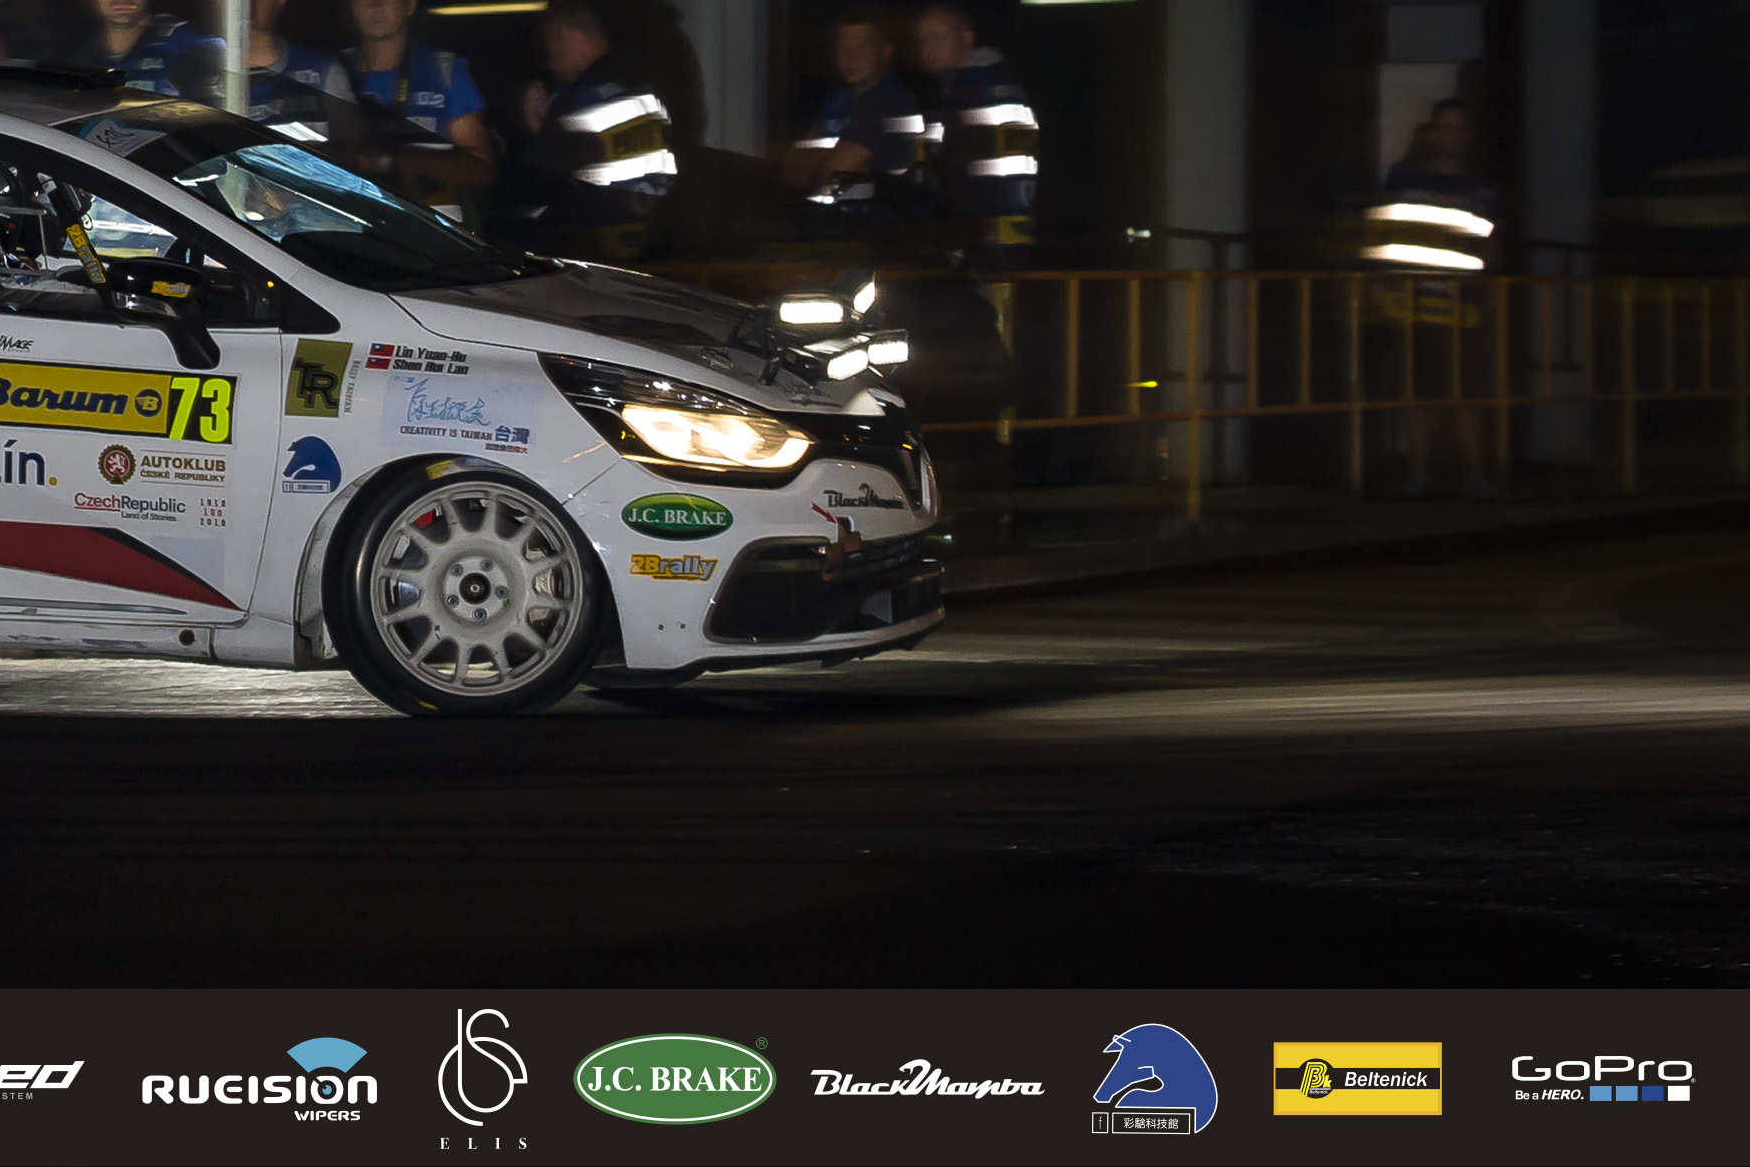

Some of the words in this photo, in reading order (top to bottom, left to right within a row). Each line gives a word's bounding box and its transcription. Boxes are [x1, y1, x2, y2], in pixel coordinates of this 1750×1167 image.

[396, 345, 414, 359] Lin
[417, 347, 468, 363] Yuan-Hu
[392, 359, 422, 371] Shen
[424, 361, 444, 373] Hui
[447, 363, 469, 375] Lan
[169, 377, 231, 443] 73
[400, 425, 447, 437] CREATIVITY
[495, 425, 530, 444] 台灣
[140, 455, 226, 472] AUTOKLUB
[174, 472, 226, 482] REPUBLIKY
[628, 507, 659, 523] J.C.
[664, 509, 727, 526] BRAKE
[630, 554, 718, 581] 2Brally
